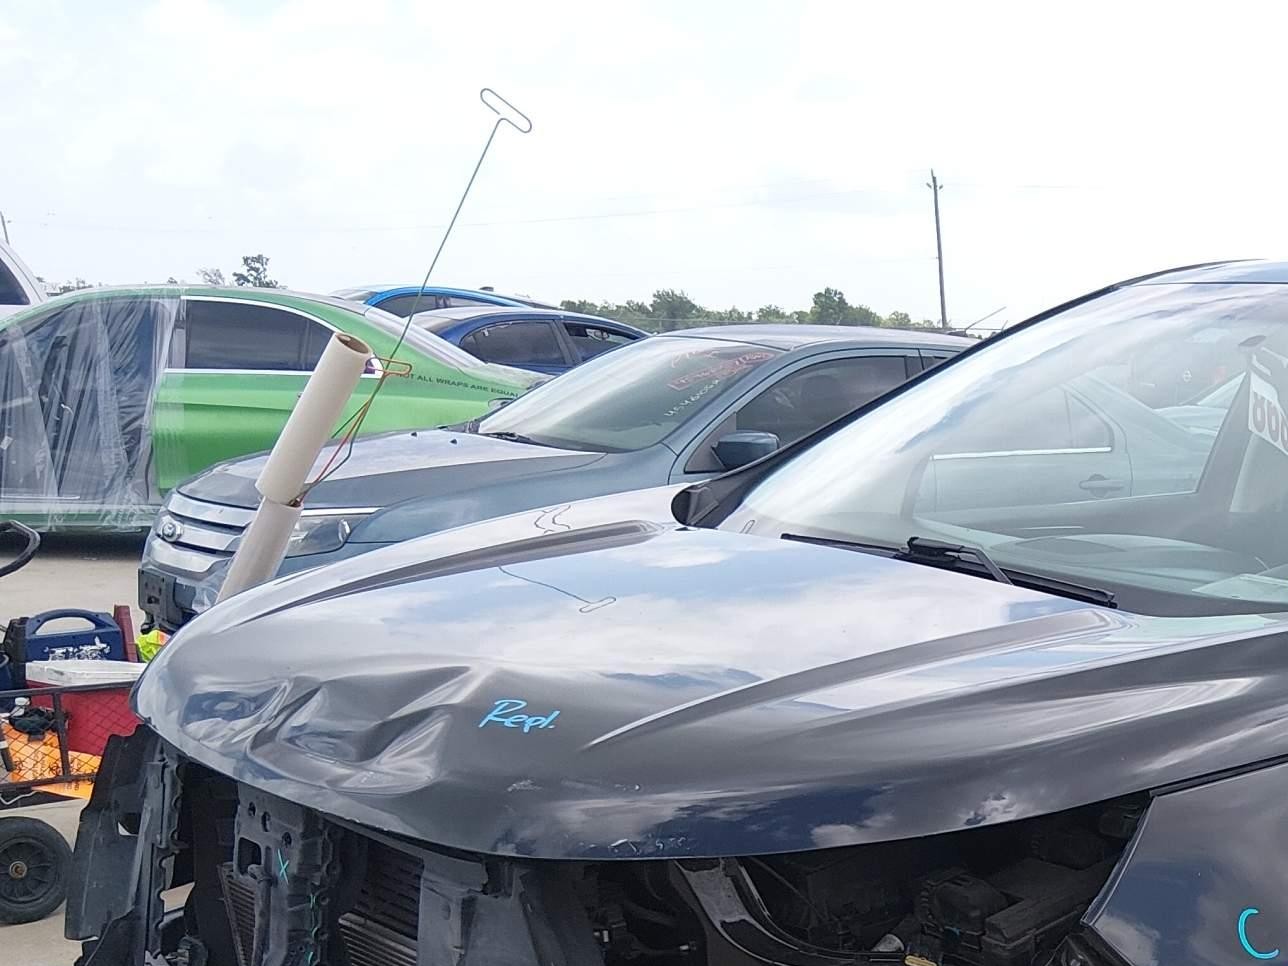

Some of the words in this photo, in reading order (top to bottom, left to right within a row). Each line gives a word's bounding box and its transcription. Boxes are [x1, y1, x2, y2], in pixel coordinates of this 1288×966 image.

[417, 375, 433, 383] ALL
[436, 378, 469, 388] WRAPS
[470, 384, 488, 392] ARE
